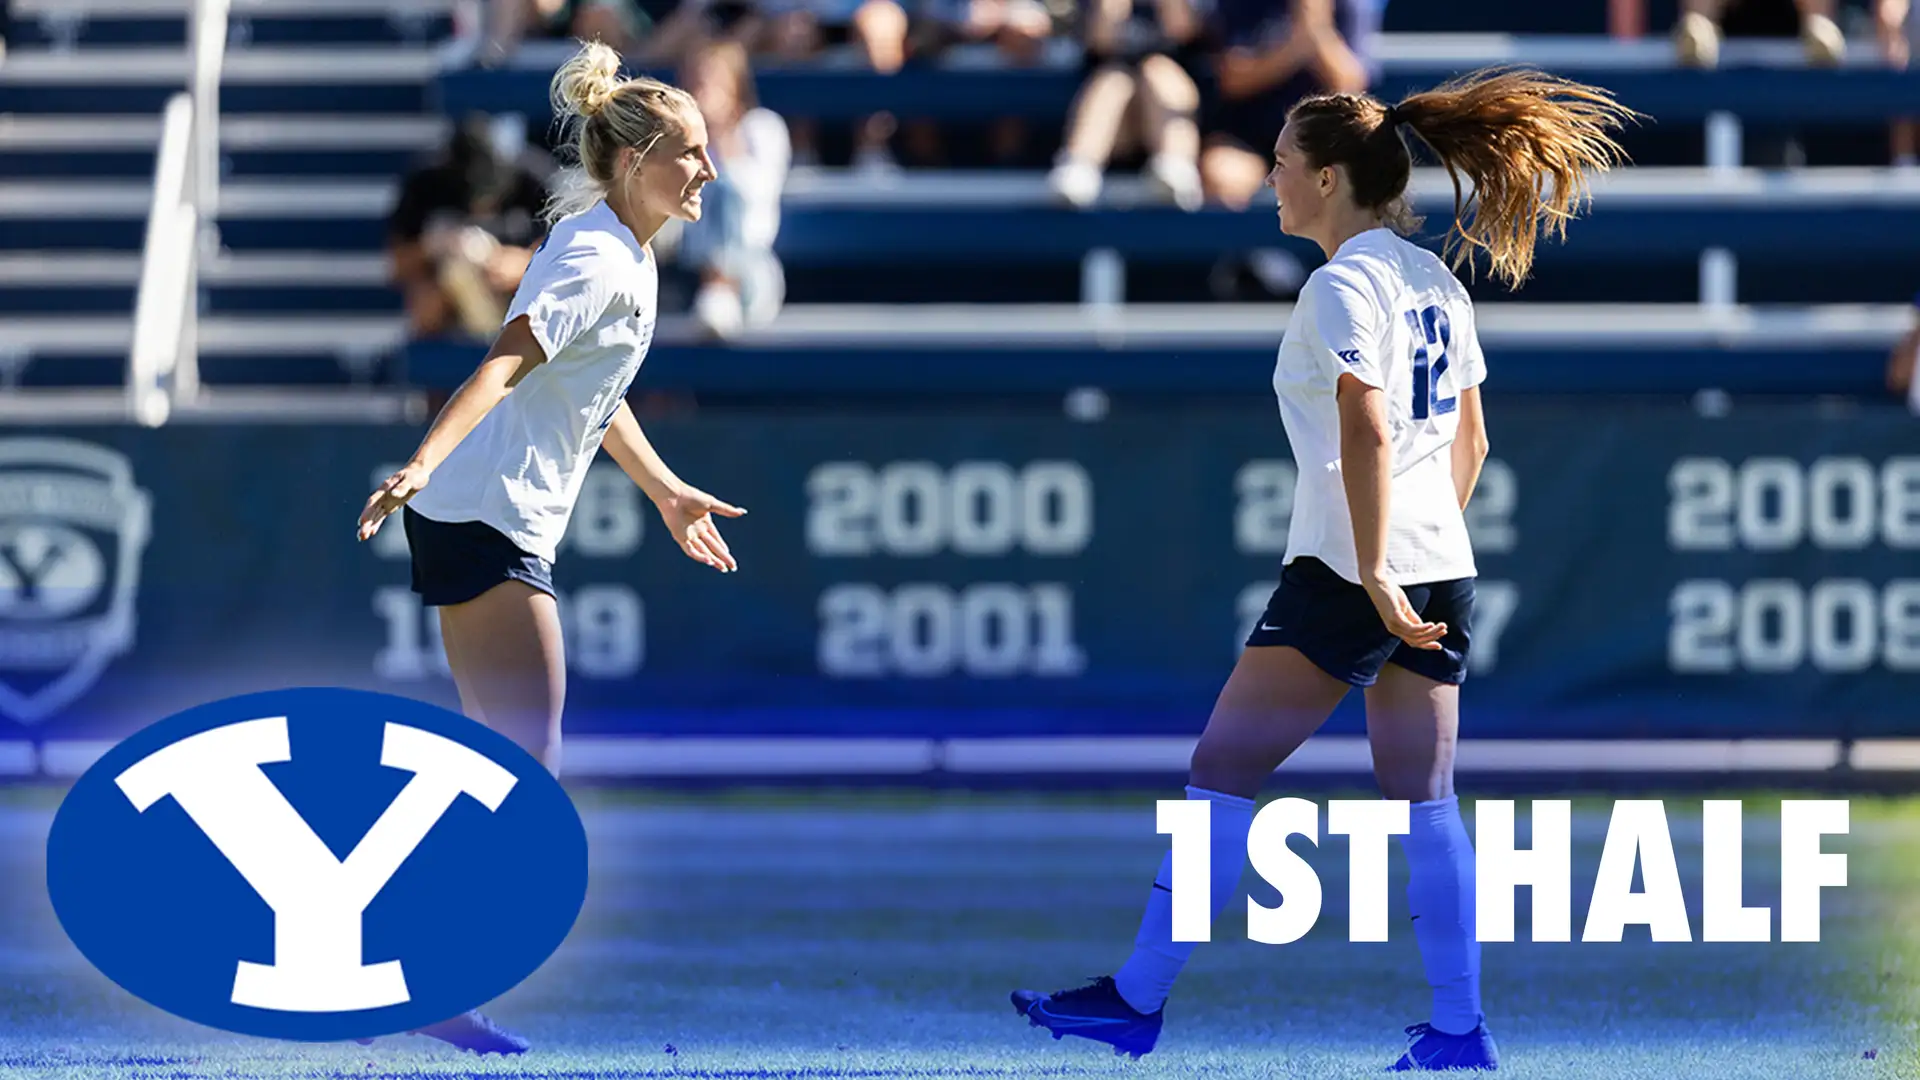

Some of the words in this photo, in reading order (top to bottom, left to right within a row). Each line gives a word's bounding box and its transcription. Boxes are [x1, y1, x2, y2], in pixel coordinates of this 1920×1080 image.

[1404, 305, 1456, 419] 12
[805, 460, 1092, 556] 2000
[817, 584, 1087, 678] 2001
